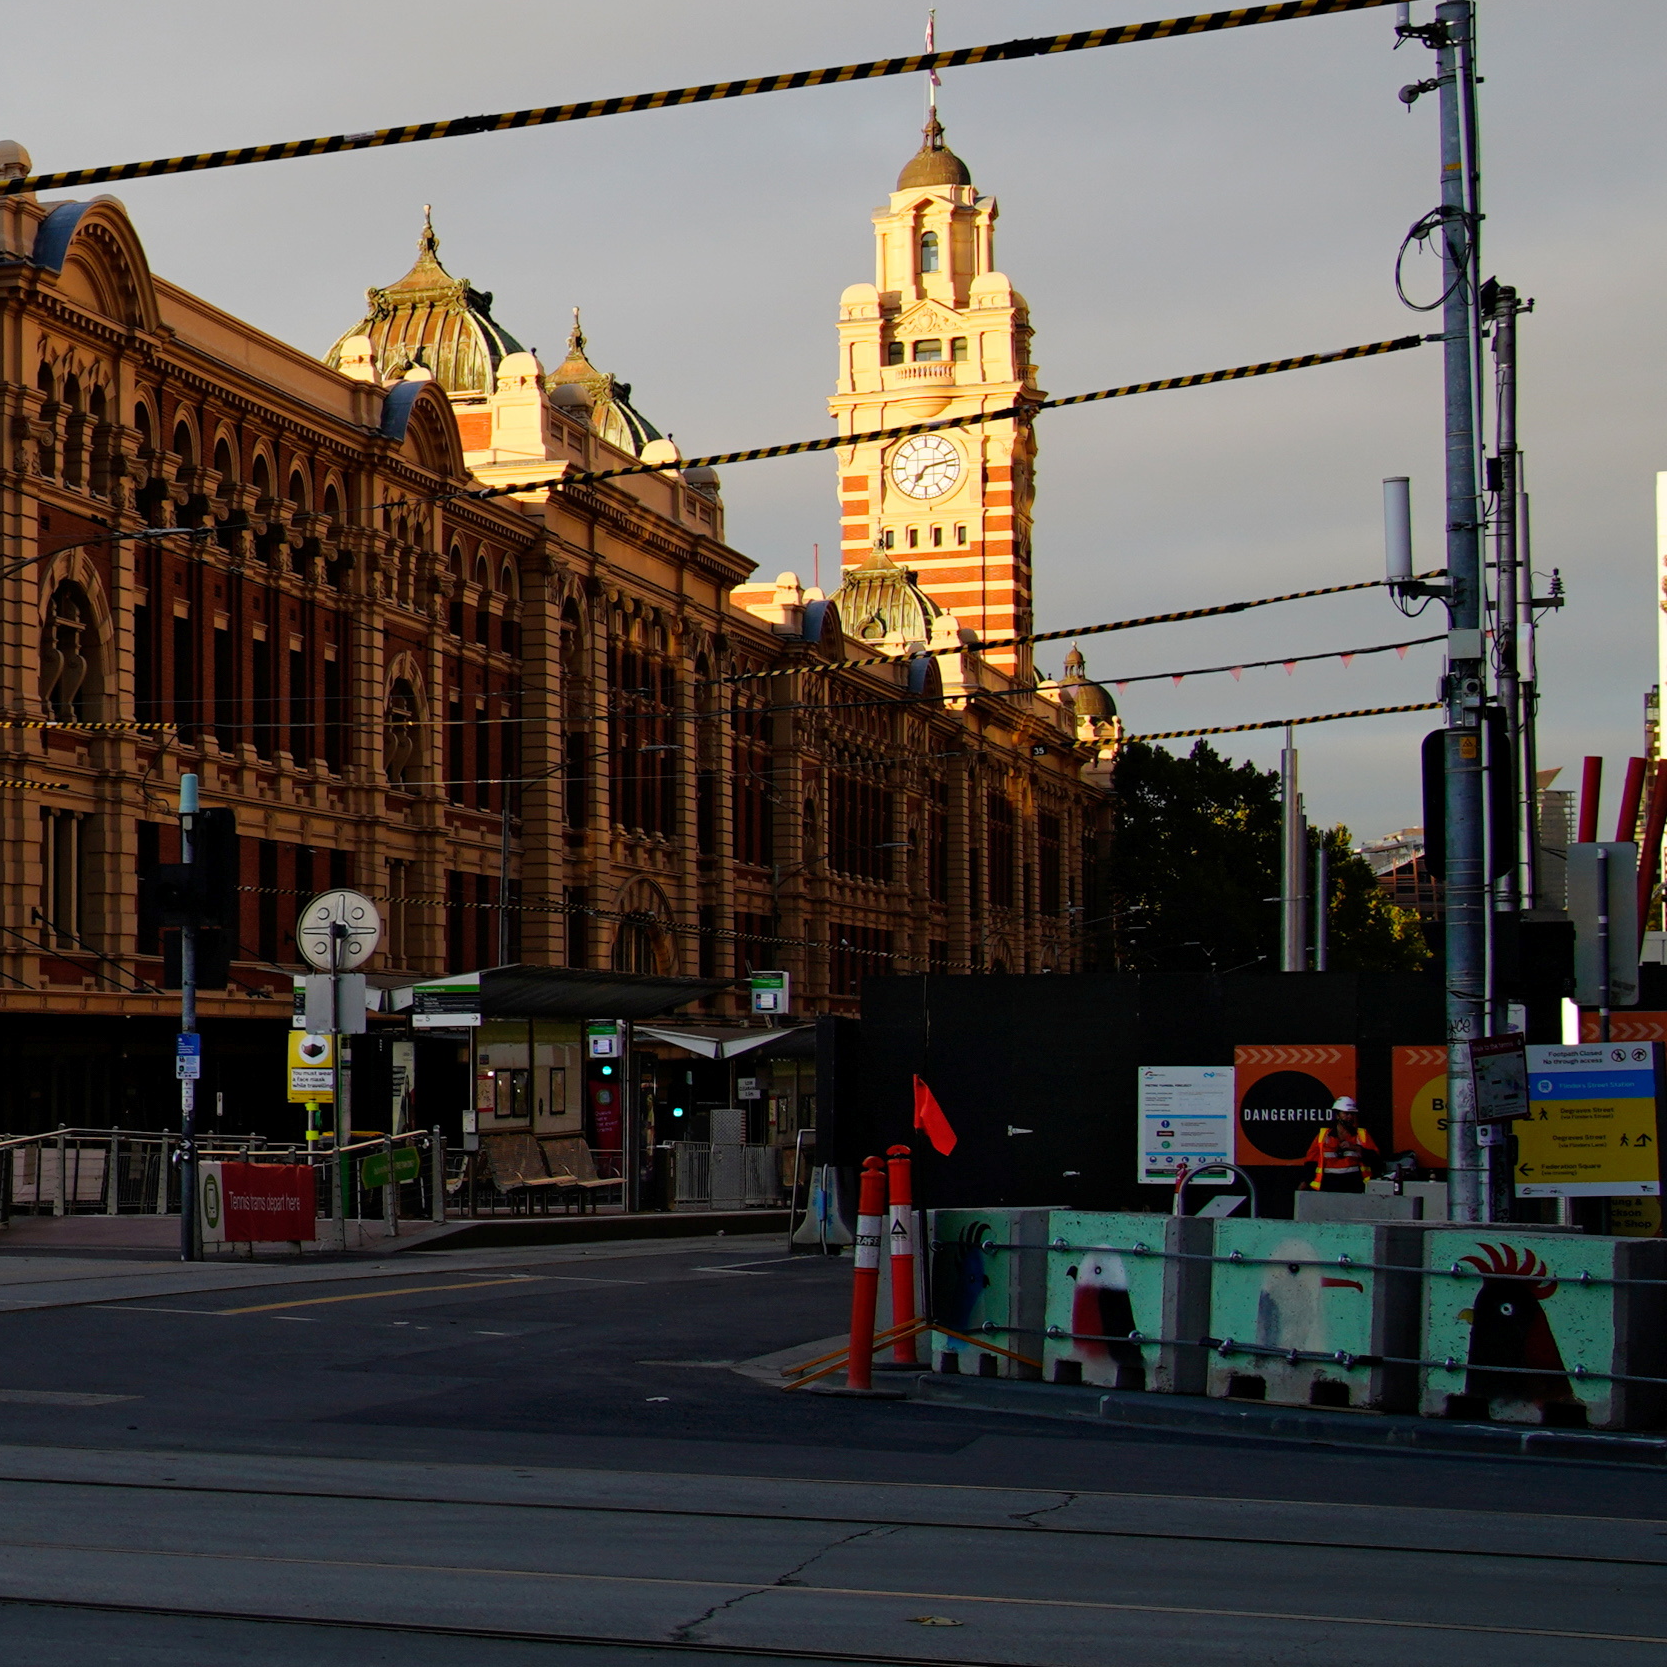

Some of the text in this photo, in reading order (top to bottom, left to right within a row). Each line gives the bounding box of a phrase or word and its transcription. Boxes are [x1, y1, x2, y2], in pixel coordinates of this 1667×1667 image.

[1243, 1108, 1334, 1122] DANGERFIELD
[228, 1190, 249, 1210] Tennis
[267, 1193, 285, 1215] depart
[286, 1193, 301, 1211] here
[1611, 1198, 1643, 1206] ung &
[1611, 1209, 1642, 1217] ckson
[1624, 1219, 1652, 1229] Shop
